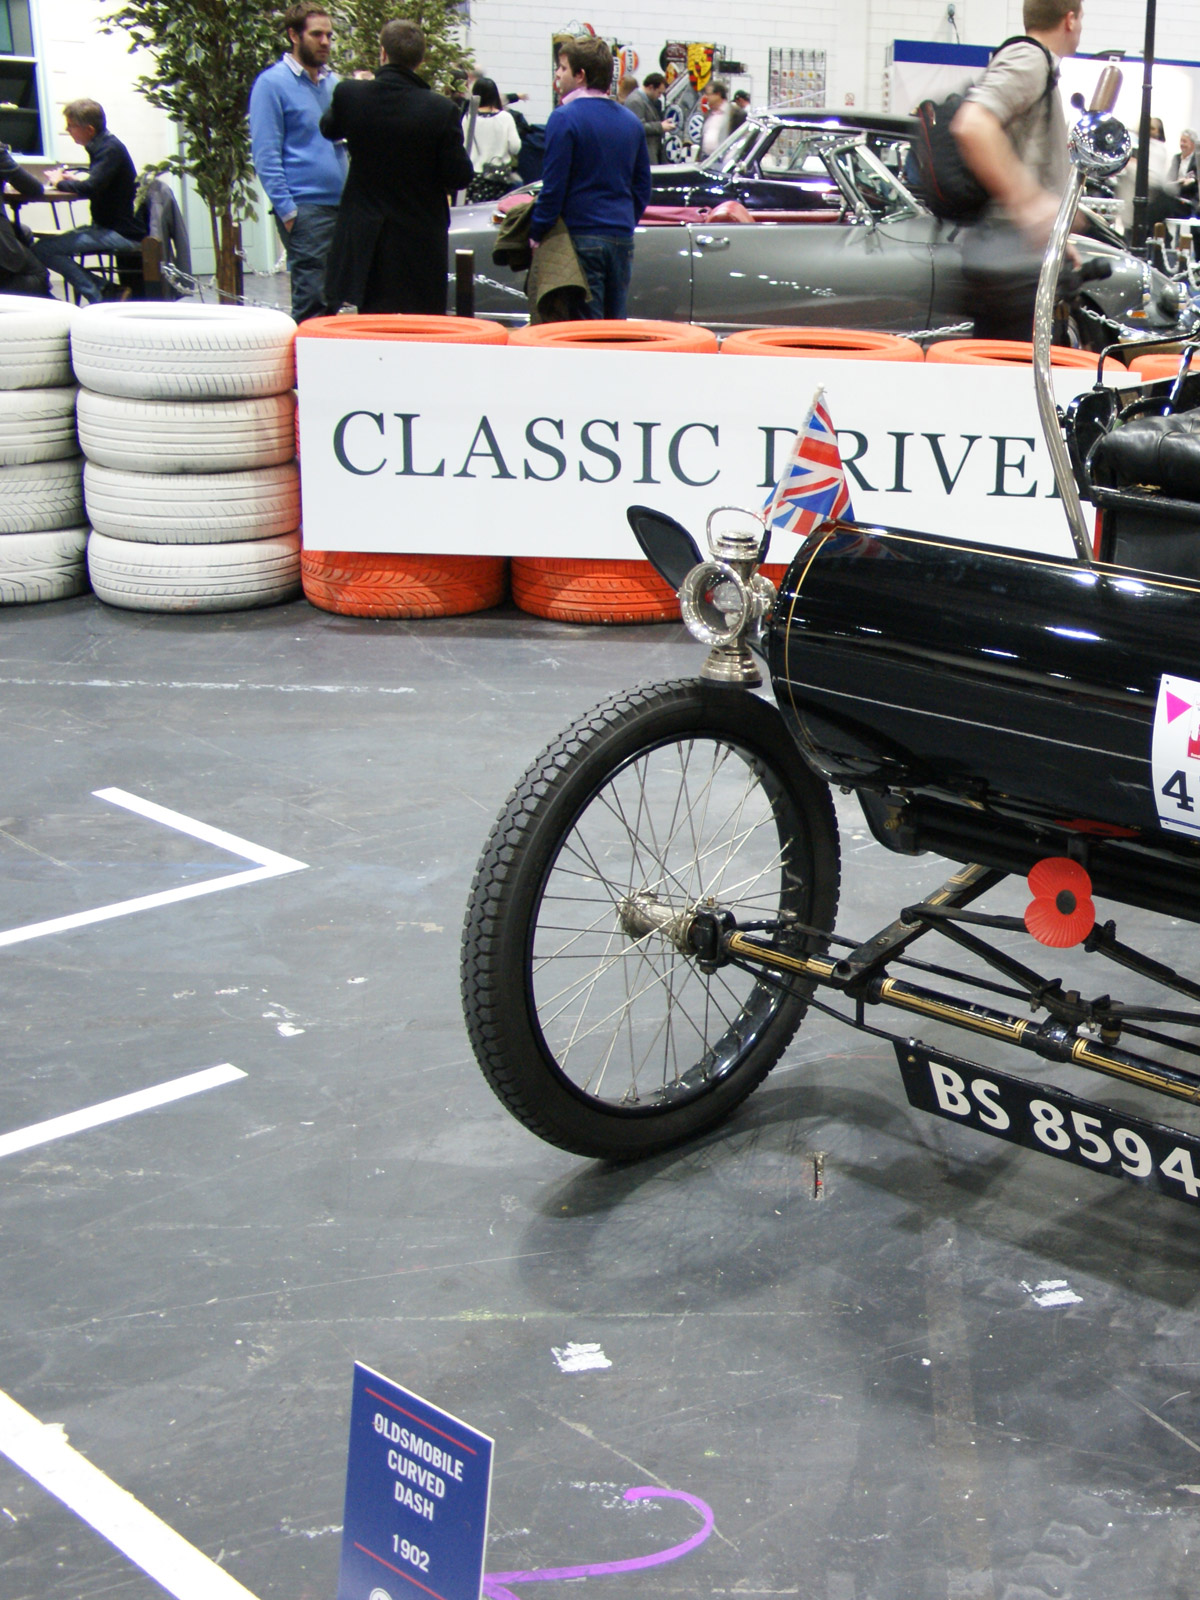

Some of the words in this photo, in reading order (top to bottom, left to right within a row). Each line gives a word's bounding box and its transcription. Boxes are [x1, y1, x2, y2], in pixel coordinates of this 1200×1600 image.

[332, 409, 721, 486] CLASSIC
[756, 425, 1063, 499] DRIVE
[928, 1061, 1011, 1131] BS
[373, 1412, 464, 1482] OLDSMOBILE
[387, 1448, 446, 1499] CURVED
[394, 1480, 435, 1522] DASH
[391, 1533, 431, 1574] 1902
